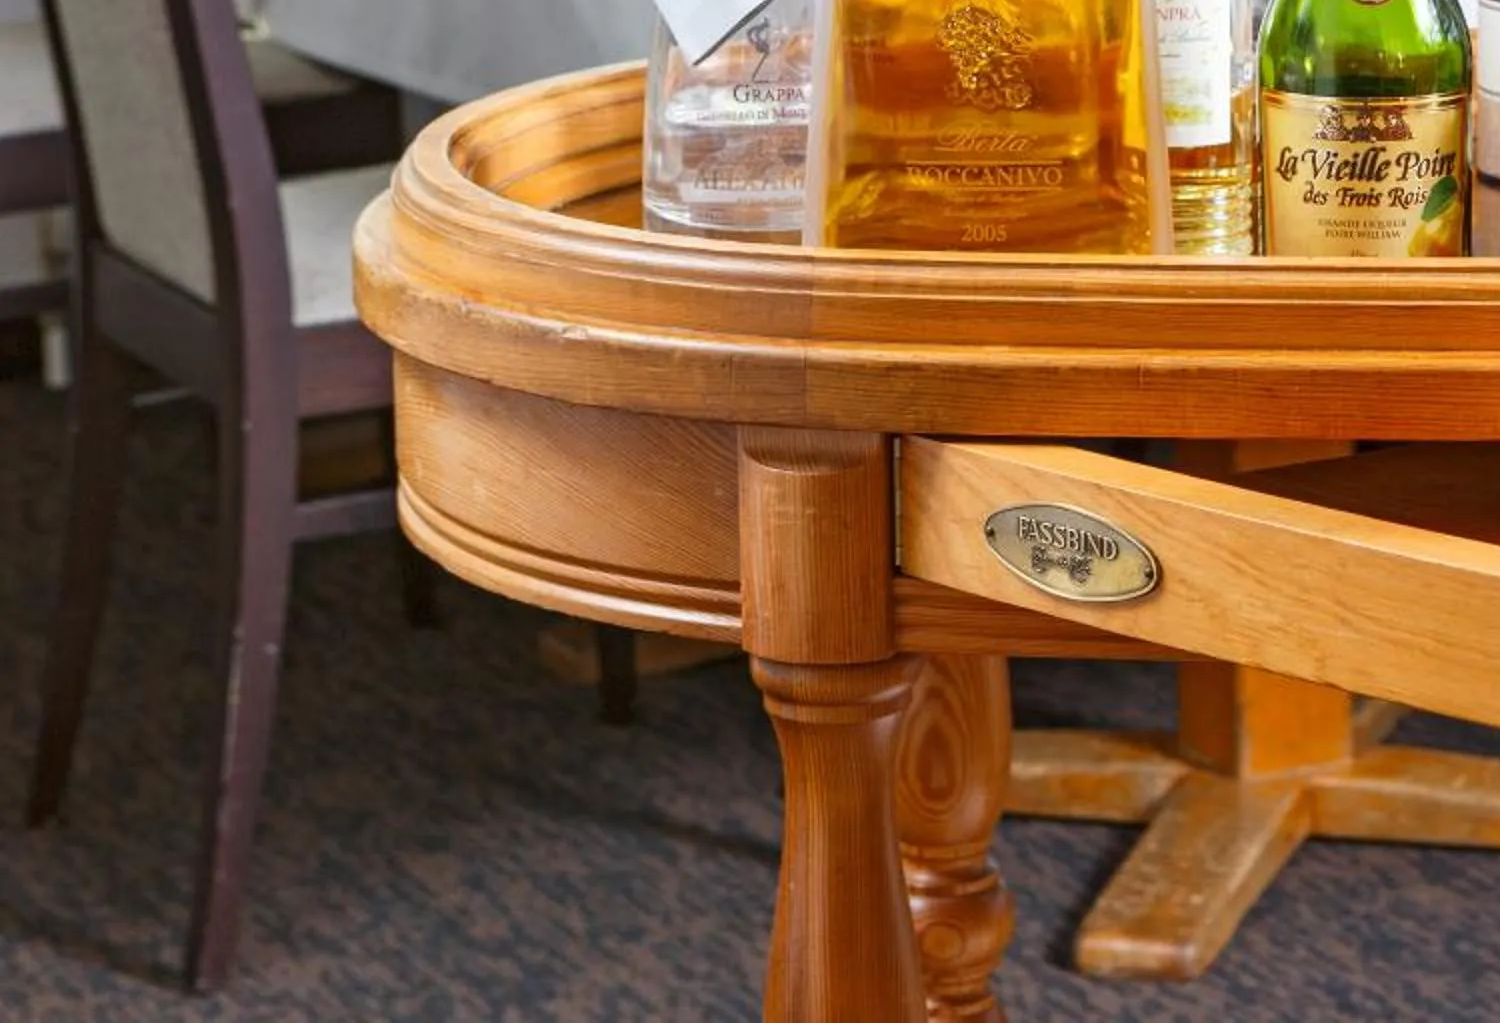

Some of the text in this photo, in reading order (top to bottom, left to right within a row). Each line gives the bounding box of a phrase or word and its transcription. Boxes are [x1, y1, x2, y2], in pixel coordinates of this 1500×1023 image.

[733, 84, 806, 103] GRAPPA
[1275, 146, 1299, 183] La
[1301, 146, 1393, 184] Vieille
[1303, 180, 1428, 209] des Trois Rois
[961, 224, 1008, 242] 2005
[1017, 515, 1119, 562] FASSBIND
